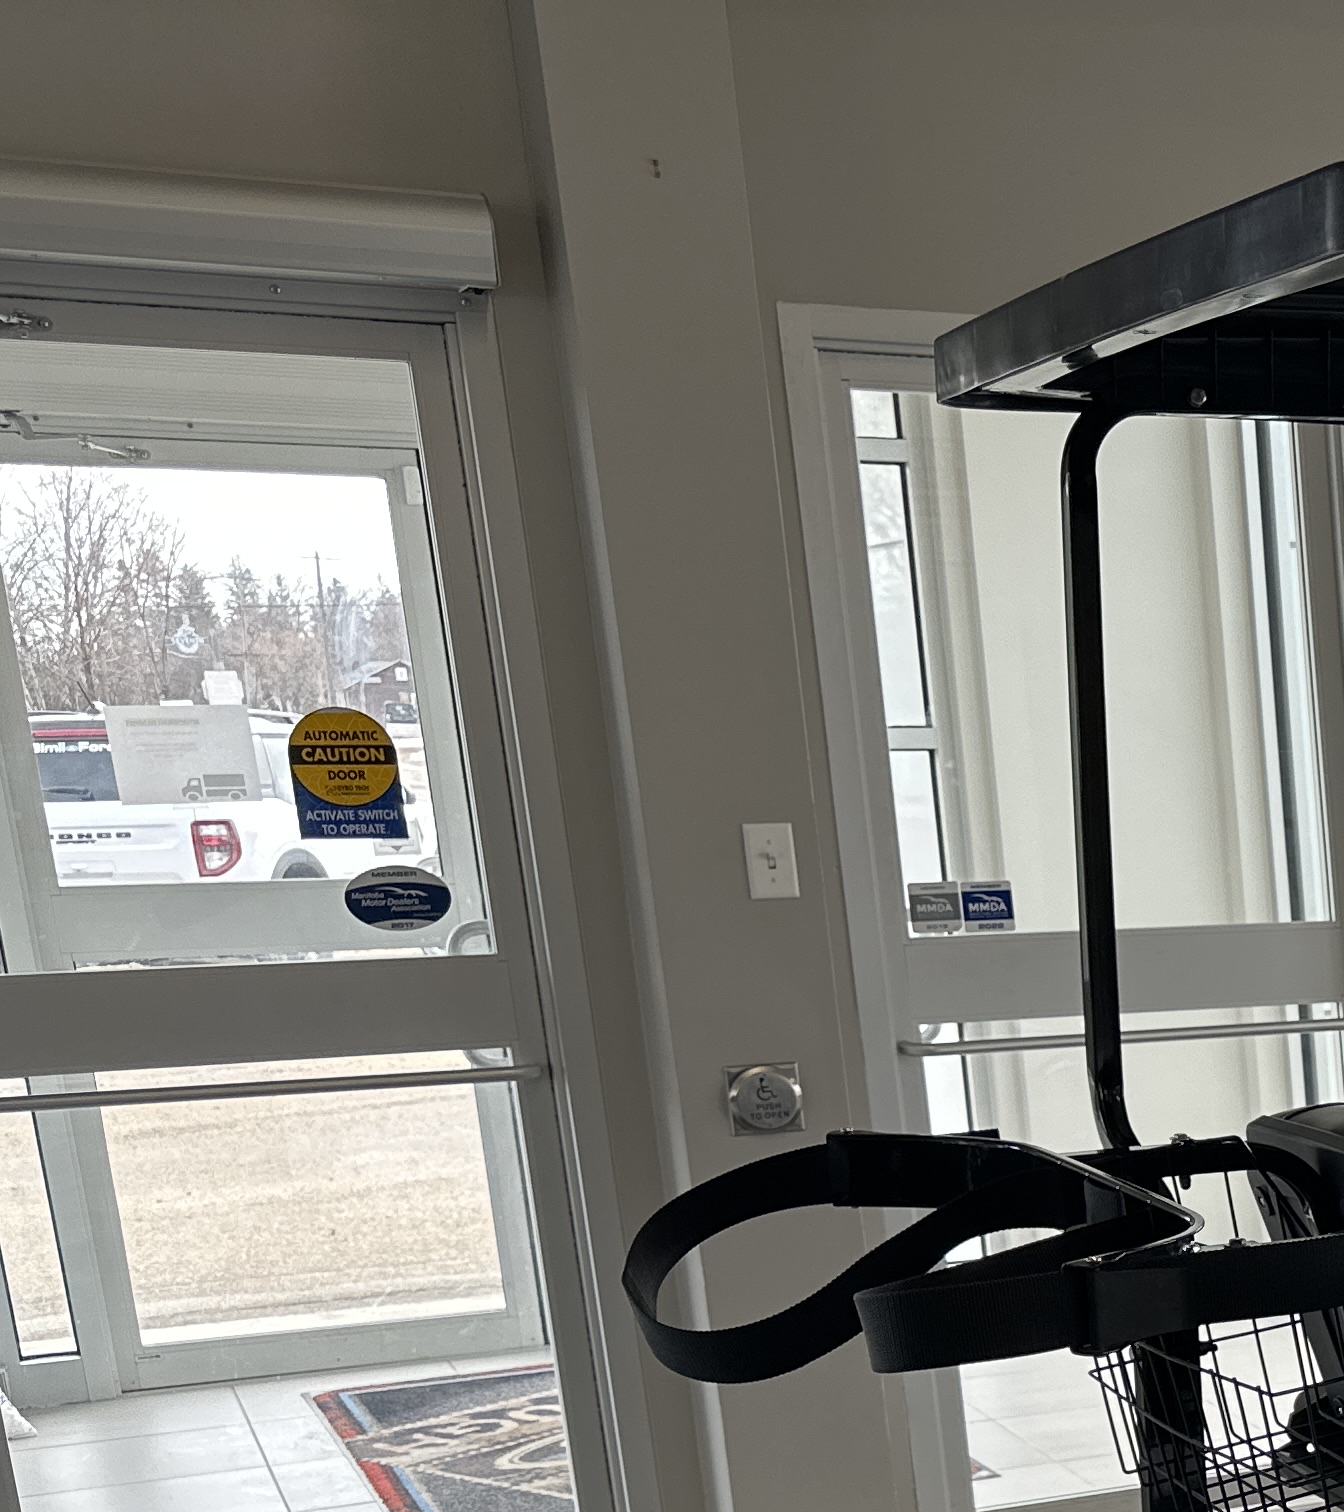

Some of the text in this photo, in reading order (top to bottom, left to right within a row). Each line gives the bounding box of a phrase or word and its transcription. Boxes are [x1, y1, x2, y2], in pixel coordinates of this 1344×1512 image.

[304, 730, 378, 741] AUTOMATIC
[301, 748, 385, 762] CAUTION
[328, 770, 366, 781] DOOR
[306, 809, 398, 821] ACTIVATE SWITCH
[322, 825, 337, 835] TO
[361, 897, 420, 907] Motor Dealers
[968, 902, 1008, 912] MMDA
[916, 903, 954, 913] MMDA
[756, 1102, 782, 1111] PUSH
[751, 1110, 790, 1120] TO OPEN
